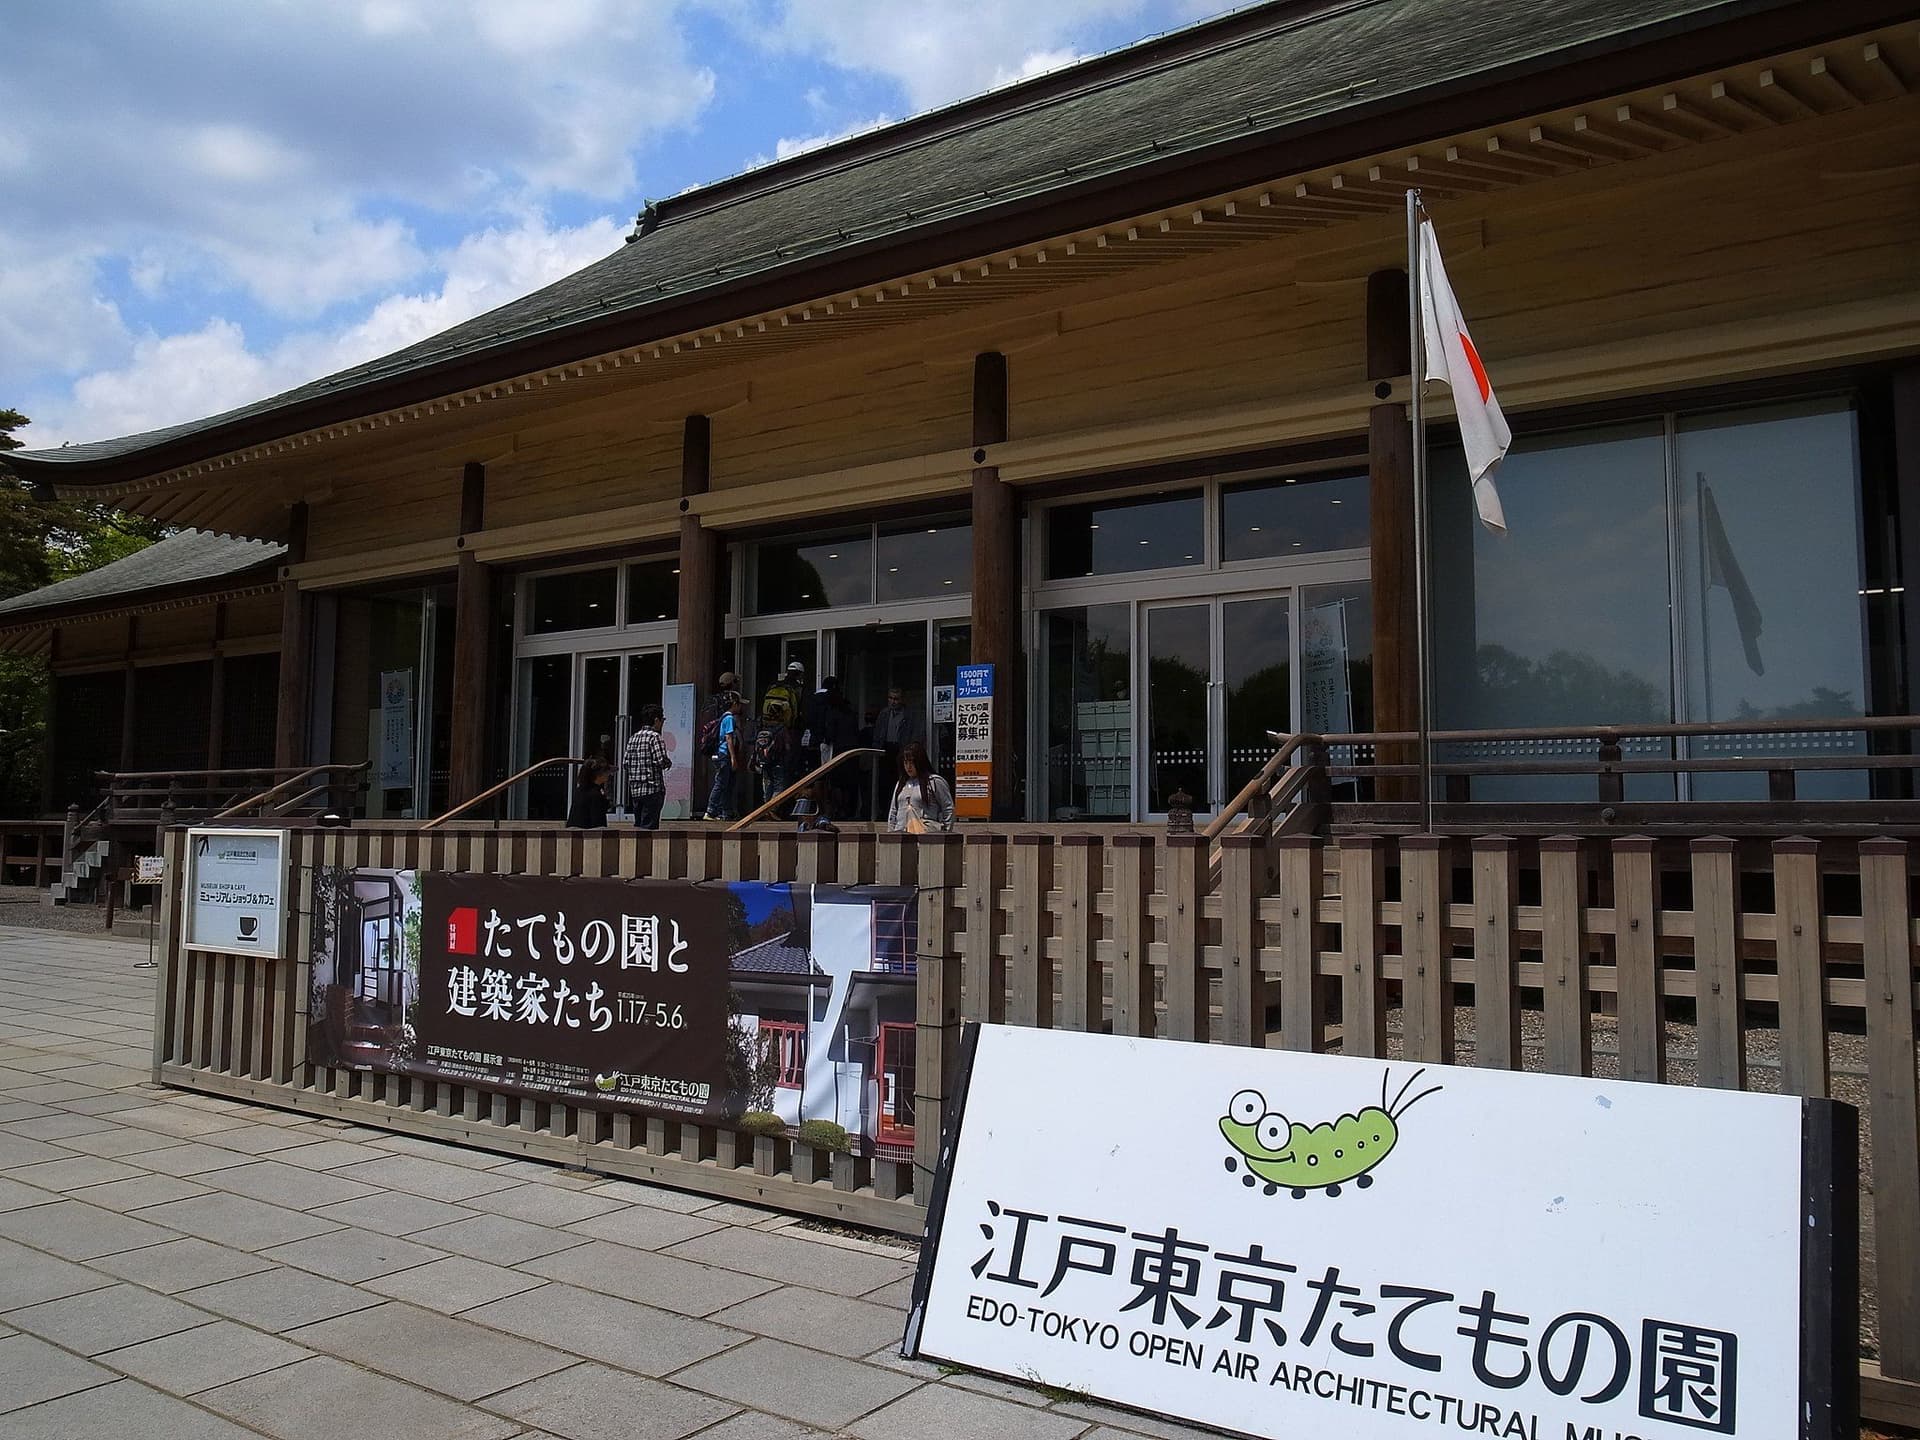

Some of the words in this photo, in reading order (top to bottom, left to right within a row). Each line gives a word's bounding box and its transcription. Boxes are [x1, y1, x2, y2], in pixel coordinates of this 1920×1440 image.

[959, 670, 989, 679] 1500円で
[959, 686, 989, 695] フリーパス
[958, 702, 989, 712] たてもの園
[958, 711, 989, 726] 友の会
[958, 726, 989, 741] 募集中
[483, 908, 689, 973] たてもの園と
[446, 965, 614, 1032] 建築家たち
[620, 1073, 710, 1099] 江戸東京たてもの園
[970, 1199, 1738, 1435] 江戸東京たてもの園
[966, 1294, 1120, 1350] EDO-TOKYO
[1129, 1330, 1204, 1369] OPEN
[1212, 1349, 1260, 1382] AIR
[1269, 1361, 1539, 1440] ARCHITECTURAL
